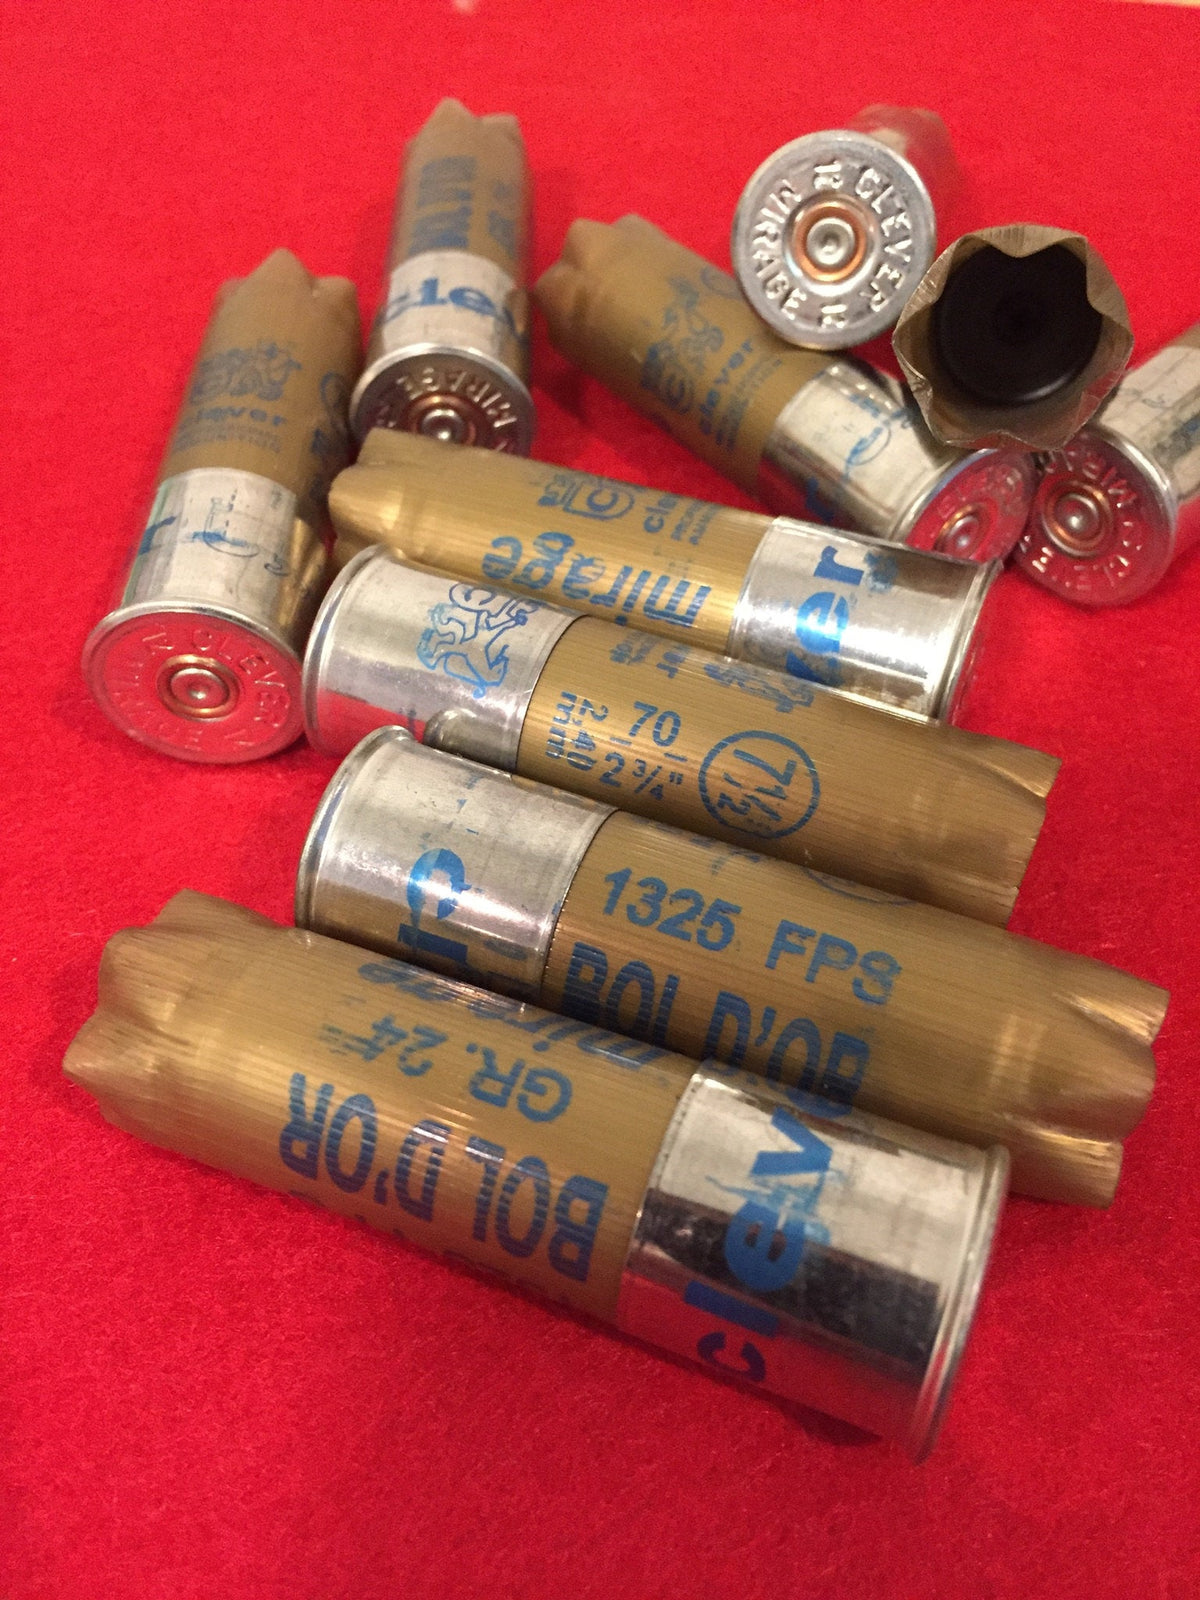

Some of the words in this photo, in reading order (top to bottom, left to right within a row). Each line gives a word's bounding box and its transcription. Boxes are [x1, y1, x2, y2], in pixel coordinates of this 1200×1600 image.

[752, 178, 807, 321] MIRAGE
[854, 167, 913, 313] CLEVER
[481, 531, 713, 628] mirage
[629, 700, 682, 747] 70
[603, 866, 743, 952] 1325
[764, 918, 903, 1006] FPS
[279, 1071, 452, 1223] D'OR
[466, 1041, 574, 1123] GR.
[464, 1135, 610, 1283] BOL
